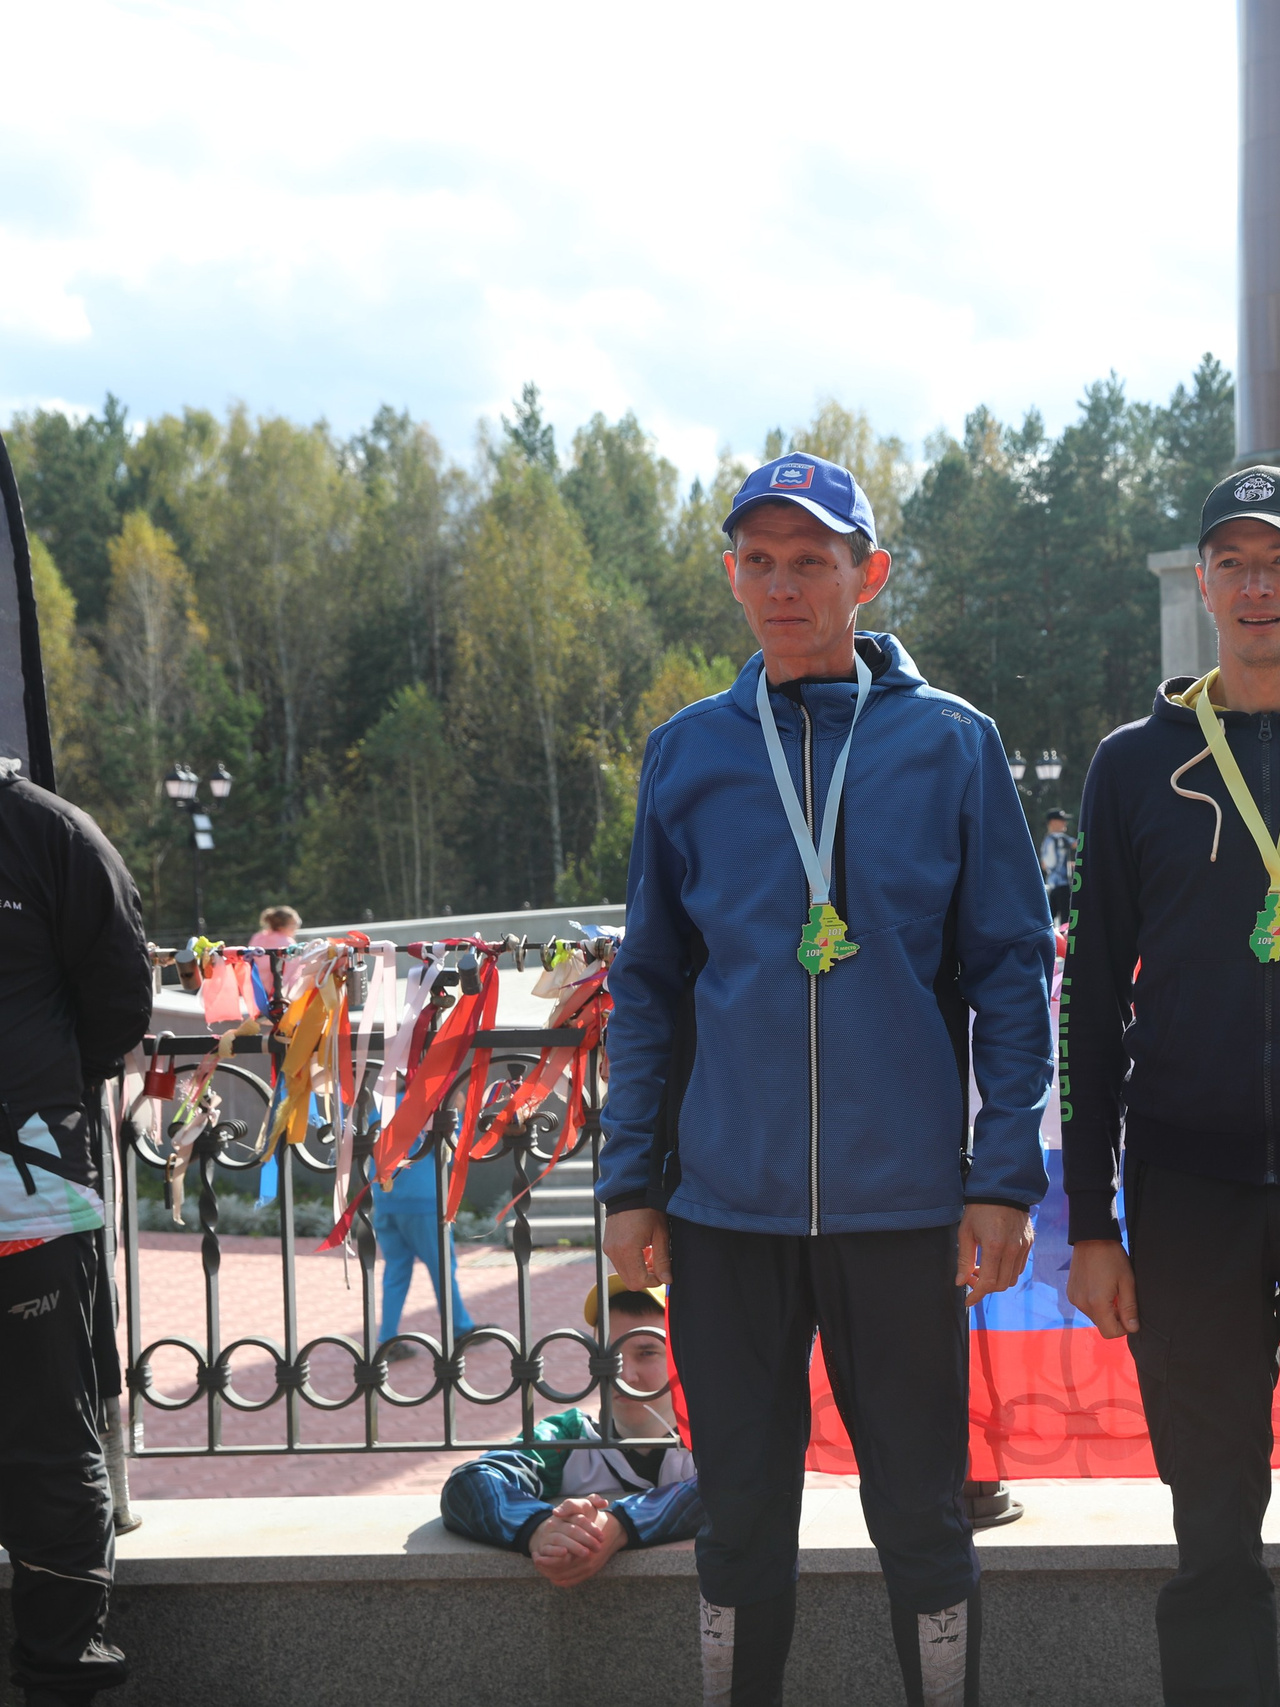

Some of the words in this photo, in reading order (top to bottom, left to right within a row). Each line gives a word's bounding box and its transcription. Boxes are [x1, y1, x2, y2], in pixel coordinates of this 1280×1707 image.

[941, 708, 972, 725] CMP
[828, 928, 842, 936] 101
[1257, 937, 1273, 945] 101
[805, 949, 821, 958] 101
